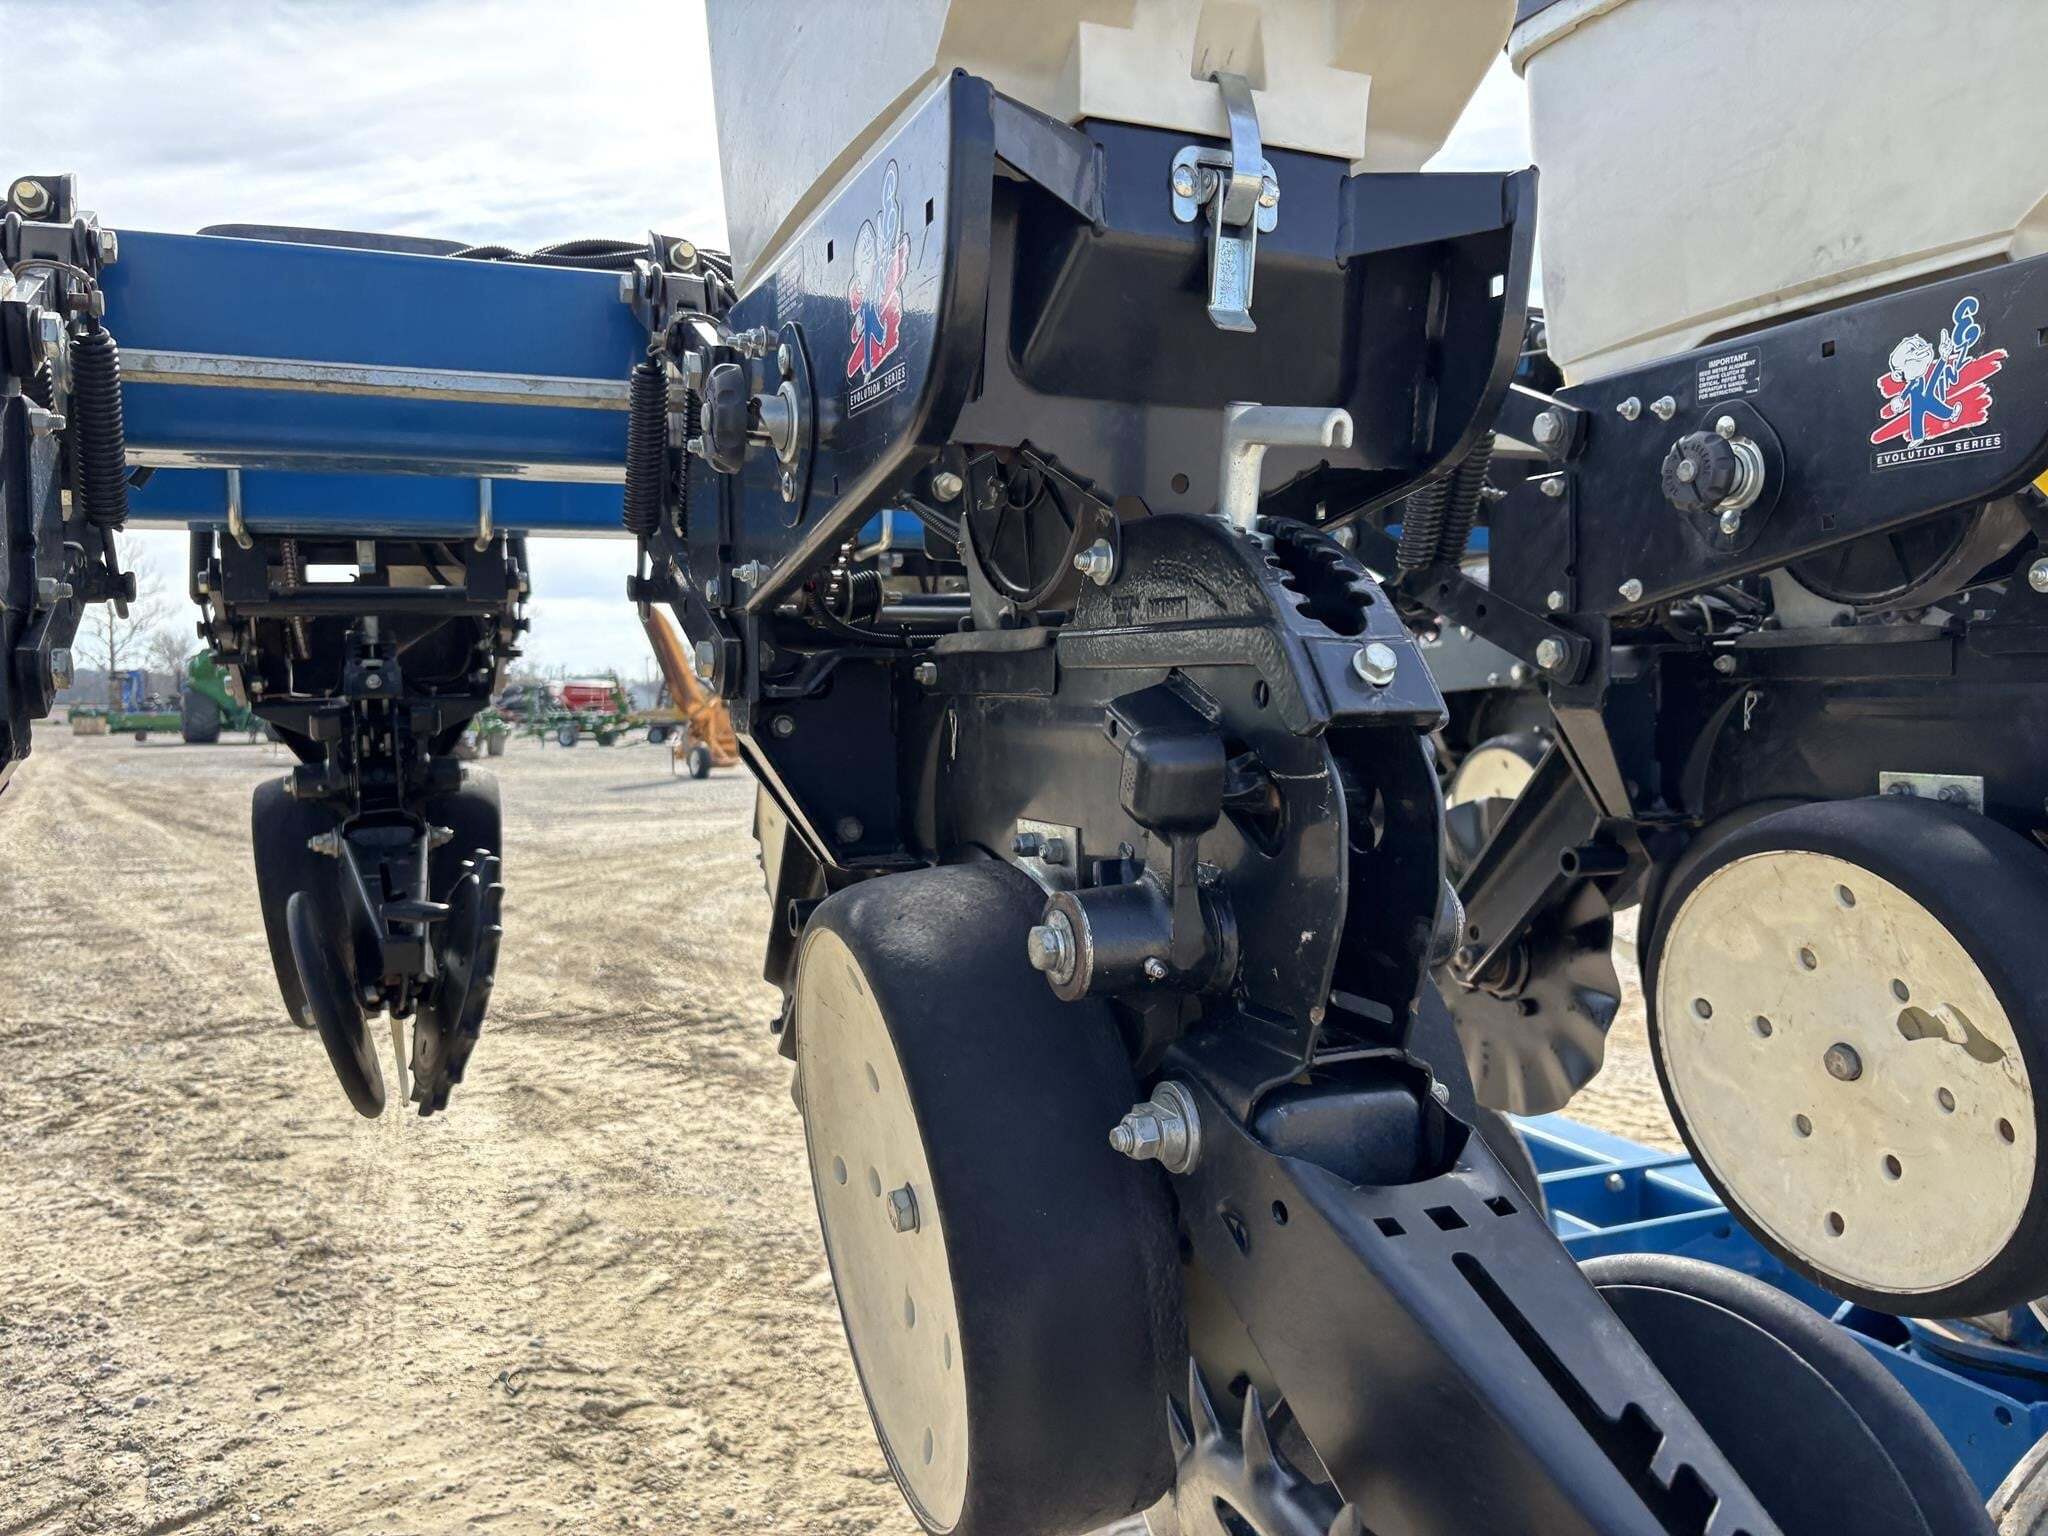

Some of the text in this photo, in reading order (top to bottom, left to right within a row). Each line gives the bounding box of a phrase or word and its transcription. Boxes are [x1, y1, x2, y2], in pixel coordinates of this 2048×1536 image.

[1709, 352, 1748, 368] IMPORTANT
[850, 366, 905, 405] EVOLUTION SERIES
[1877, 436, 2000, 465] EVOLUTION SERIES
